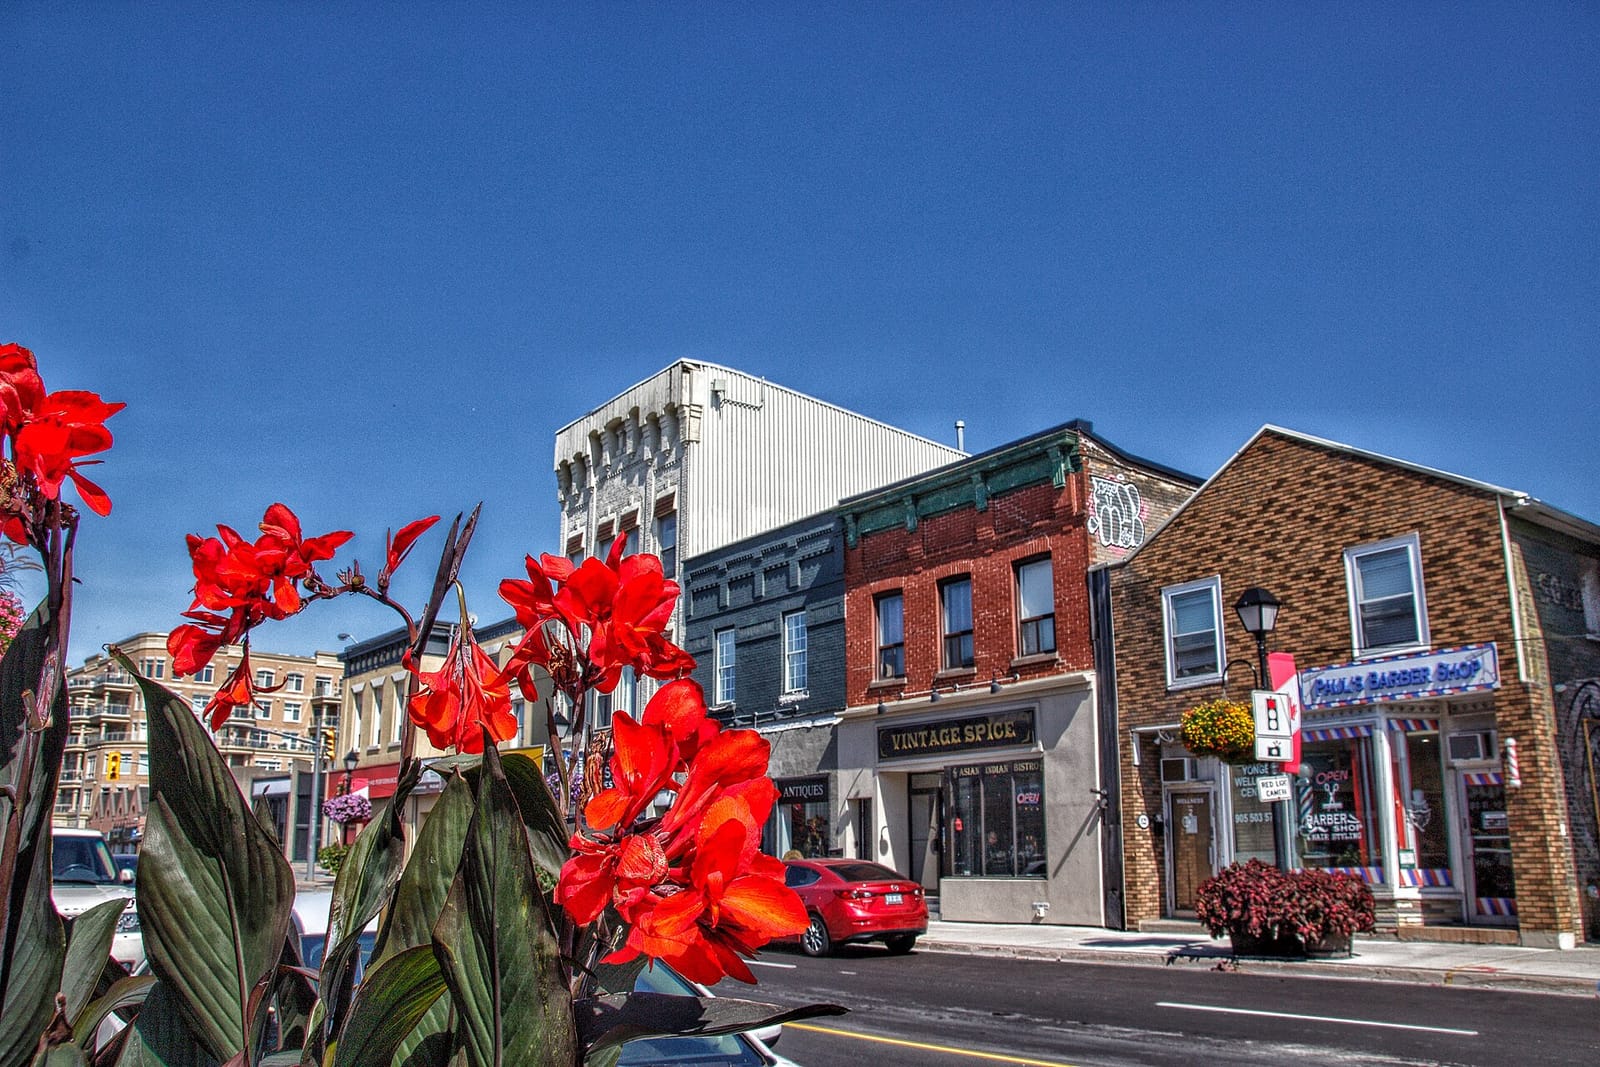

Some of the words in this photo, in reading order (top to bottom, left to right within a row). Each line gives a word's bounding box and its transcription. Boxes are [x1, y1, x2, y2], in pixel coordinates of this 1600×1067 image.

[1314, 674, 1364, 697] PAUL'S
[1368, 666, 1432, 690] BARBER
[1437, 660, 1483, 682] SHOP
[892, 727, 961, 750] VINTAGE
[964, 721, 1016, 743] SPICE
[960, 767, 979, 776] ASIAN
[985, 764, 1008, 774] INDIAN
[1014, 762, 1039, 772] BISTRO
[1242, 763, 1269, 775] YONGE
[1235, 776, 1257, 787] WELL
[1316, 770, 1348, 784] OPEN
[783, 784, 824, 798] ANTIQUES
[1017, 792, 1040, 804] OPEN
[1264, 812, 1273, 822] 57
[1306, 813, 1347, 827] BARBER
[1333, 824, 1363, 832] SHOP
